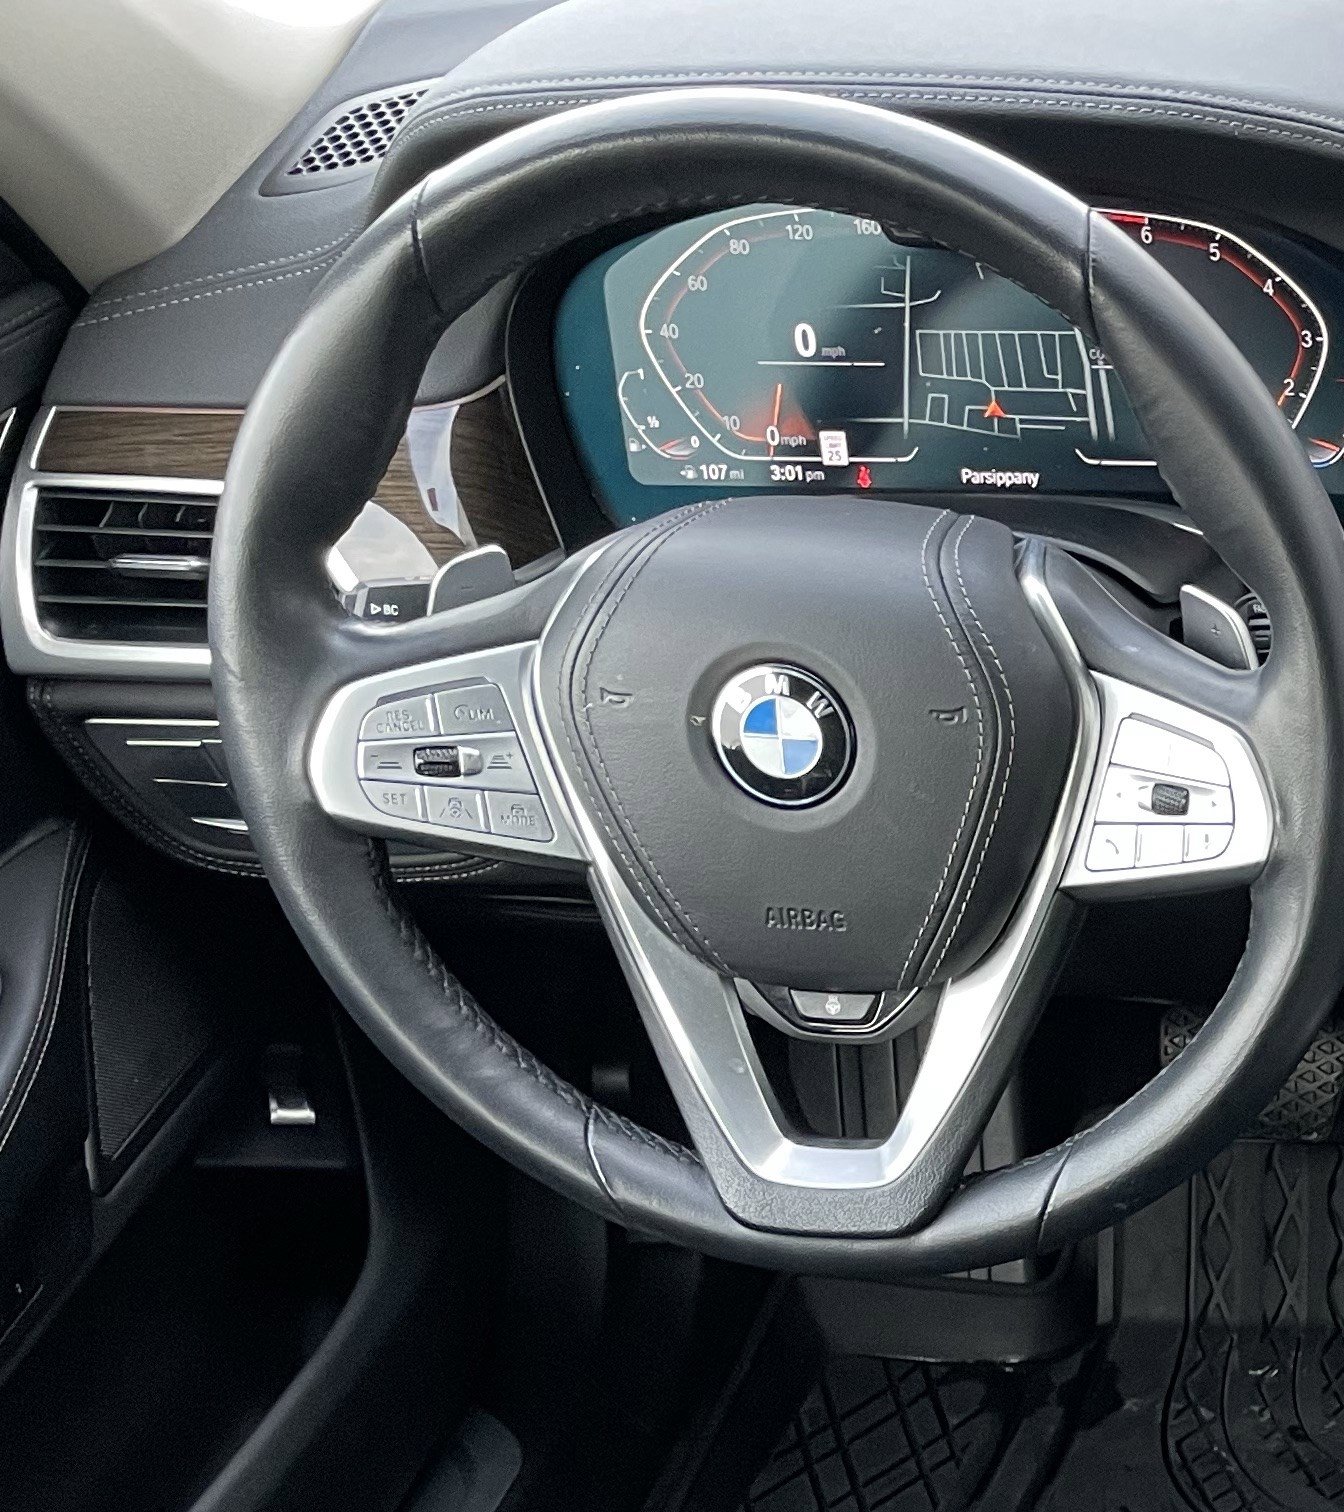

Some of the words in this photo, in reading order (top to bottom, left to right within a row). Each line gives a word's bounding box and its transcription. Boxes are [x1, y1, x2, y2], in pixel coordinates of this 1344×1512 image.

[785, 224, 813, 241] 120
[1141, 227, 1153, 244] 6
[729, 238, 750, 255] 80
[1209, 243, 1221, 261] 5
[687, 275, 707, 291] 60
[1263, 278, 1275, 296] 4
[659, 323, 679, 340] 40
[1301, 331, 1313, 348] 3
[793, 322, 818, 358] 0
[821, 344, 846, 359] mph
[684, 373, 704, 388] 20
[1283, 379, 1295, 396] 2
[723, 415, 740, 432] 10
[690, 435, 700, 448] 0
[827, 450, 842, 461] 25
[700, 465, 727, 480] 107
[730, 468, 744, 480] mi
[770, 465, 803, 481] 3:01
[961, 468, 1040, 488] Parsippany
[383, 604, 399, 616] BC
[724, 673, 835, 719] BMW
[376, 721, 425, 734] CANCEL
[382, 792, 406, 805] SET
[765, 905, 848, 932] AIRBAG
